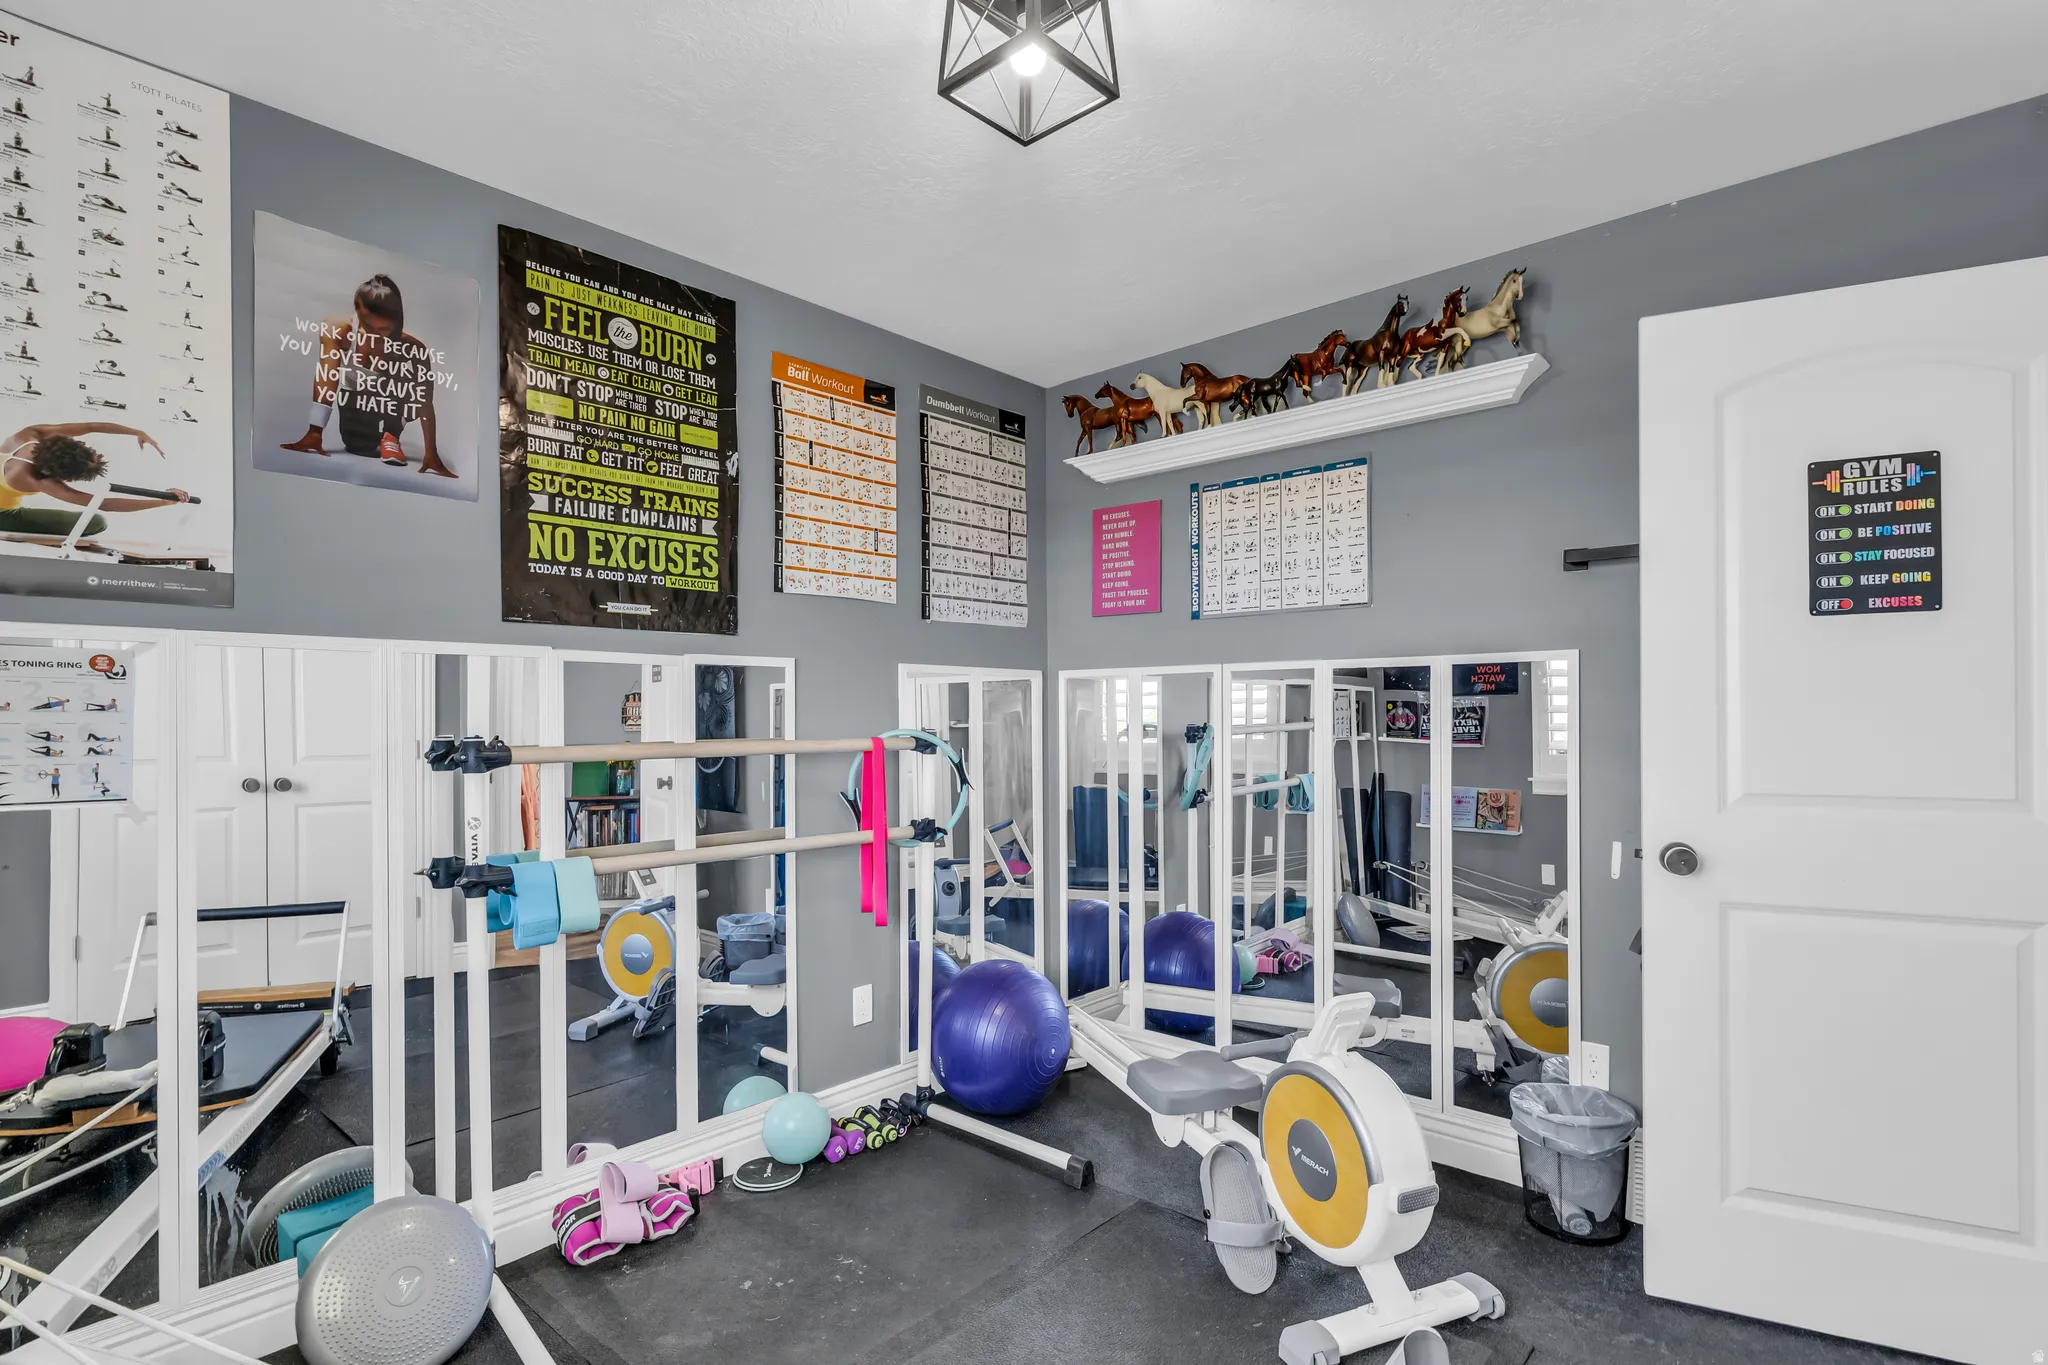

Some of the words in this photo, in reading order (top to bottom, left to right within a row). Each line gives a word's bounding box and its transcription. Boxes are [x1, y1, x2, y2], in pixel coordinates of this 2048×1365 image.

[131, 81, 162, 98] STOTT
[166, 93, 202, 113] PILATES
[526, 260, 560, 276] BELIEVE
[564, 272, 580, 282] YOU
[584, 279, 600, 289] CAN
[603, 285, 618, 294] AND
[622, 290, 636, 300] YOU
[640, 296, 653, 305] ARE
[656, 301, 675, 312] HALF
[677, 308, 692, 318] WAY
[695, 314, 715, 325] THERE
[531, 274, 550, 290] PAIN
[557, 281, 564, 294] IS
[571, 286, 590, 302] JUST
[596, 293, 637, 316] WEAKNESS
[643, 308, 672, 328] LEAVING
[678, 319, 689, 333] THE
[695, 324, 712, 339] BODY
[295, 316, 342, 340] WORK
[347, 331, 380, 348] OUT
[384, 337, 445, 364] BECAUSE
[544, 296, 609, 345] FEEL
[613, 326, 633, 341] the
[640, 324, 702, 370] BURN
[279, 334, 312, 356] YOU
[321, 344, 363, 367] LOVE
[369, 356, 414, 378] YOUR
[417, 364, 458, 391] BODY,
[528, 328, 584, 354] MUSCLES:
[588, 344, 609, 361] USE
[612, 350, 642, 370] THEM
[646, 360, 658, 375] OR
[662, 364, 685, 381] LOSE
[688, 371, 716, 389] THEM
[316, 362, 352, 386] NOT
[356, 370, 426, 402] BECAUSE
[526, 367, 572, 394] DON'T
[577, 380, 613, 402] STOP
[528, 348, 560, 368] TRAIN
[565, 358, 595, 376] MEAN
[611, 369, 629, 384] EAT
[632, 375, 661, 393] CLEAN
[675, 386, 692, 400] GET
[696, 391, 718, 406] LEAN
[788, 366, 809, 381] Ball
[811, 372, 855, 395] Workout
[317, 386, 349, 406] YOU
[356, 395, 398, 416] HATE
[404, 404, 427, 420] IT.
[615, 389, 633, 400] WHEN
[634, 394, 647, 404] YOU
[615, 398, 627, 408] ARE
[629, 401, 647, 412] TIRED
[655, 399, 687, 420] STOP
[926, 396, 965, 414] Dumbbell
[966, 408, 996, 424] Workout
[579, 404, 595, 420] NO
[600, 409, 627, 427] PAIN
[631, 415, 645, 432] NO
[649, 420, 675, 438] GAIN
[689, 407, 705, 418] WHEN
[707, 411, 718, 420] YOU
[689, 415, 700, 424] ARE
[703, 419, 718, 428] DONE
[528, 414, 546, 424] THE
[549, 420, 582, 431] FITTER
[586, 426, 604, 436] YOU
[608, 431, 624, 440] ARE
[627, 435, 644, 444] THE
[647, 440, 678, 451] BETTER
[681, 446, 697, 455] YOU
[700, 450, 718, 459] FEEL
[577, 435, 592, 444] GO
[594, 439, 619, 450] HARD
[638, 447, 652, 456] GO
[654, 450, 679, 462] HOME
[527, 437, 561, 456] BURN
[564, 444, 584, 460] FAT
[601, 451, 623, 468] GET
[627, 456, 644, 471] FIT
[660, 462, 684, 479] FEEL
[688, 467, 719, 484] GREAT
[1843, 457, 1902, 478] GYM
[528, 472, 632, 506] SUCCESS
[640, 490, 719, 519] TRAINS
[1843, 478, 1902, 496] RULES
[555, 497, 615, 522] FAILURE
[622, 507, 697, 533] COMPLAINS
[1110, 511, 1131, 520] EXCUSES.
[1820, 506, 1835, 516] ON
[1854, 502, 1893, 515] START
[1895, 498, 1935, 511] DOING
[1820, 530, 1836, 540] ON
[1858, 527, 1872, 538] BE
[1876, 522, 1932, 537] POSITIVE
[528, 522, 575, 563] NO
[587, 530, 719, 578] EXCUSES
[1820, 553, 1836, 563] ON
[1854, 550, 1882, 562] STAY
[1884, 547, 1935, 560] FOCUSED
[102, 578, 156, 588] merrithew
[528, 563, 567, 576] TODAY
[571, 567, 582, 577] IS
[586, 569, 594, 579] A
[598, 570, 625, 582] GOOD
[628, 574, 648, 584] DAY
[651, 576, 665, 585] TO
[669, 578, 716, 590] WORKOUT
[1821, 577, 1837, 586] ON
[1860, 574, 1889, 585] KEEP
[1892, 571, 1932, 584] GOING
[1821, 600, 1840, 610] OFF
[1868, 596, 1923, 608] EXCUSES
[11, 660, 54, 668] TONING
[1301, 1154, 1329, 1176] MERACH
